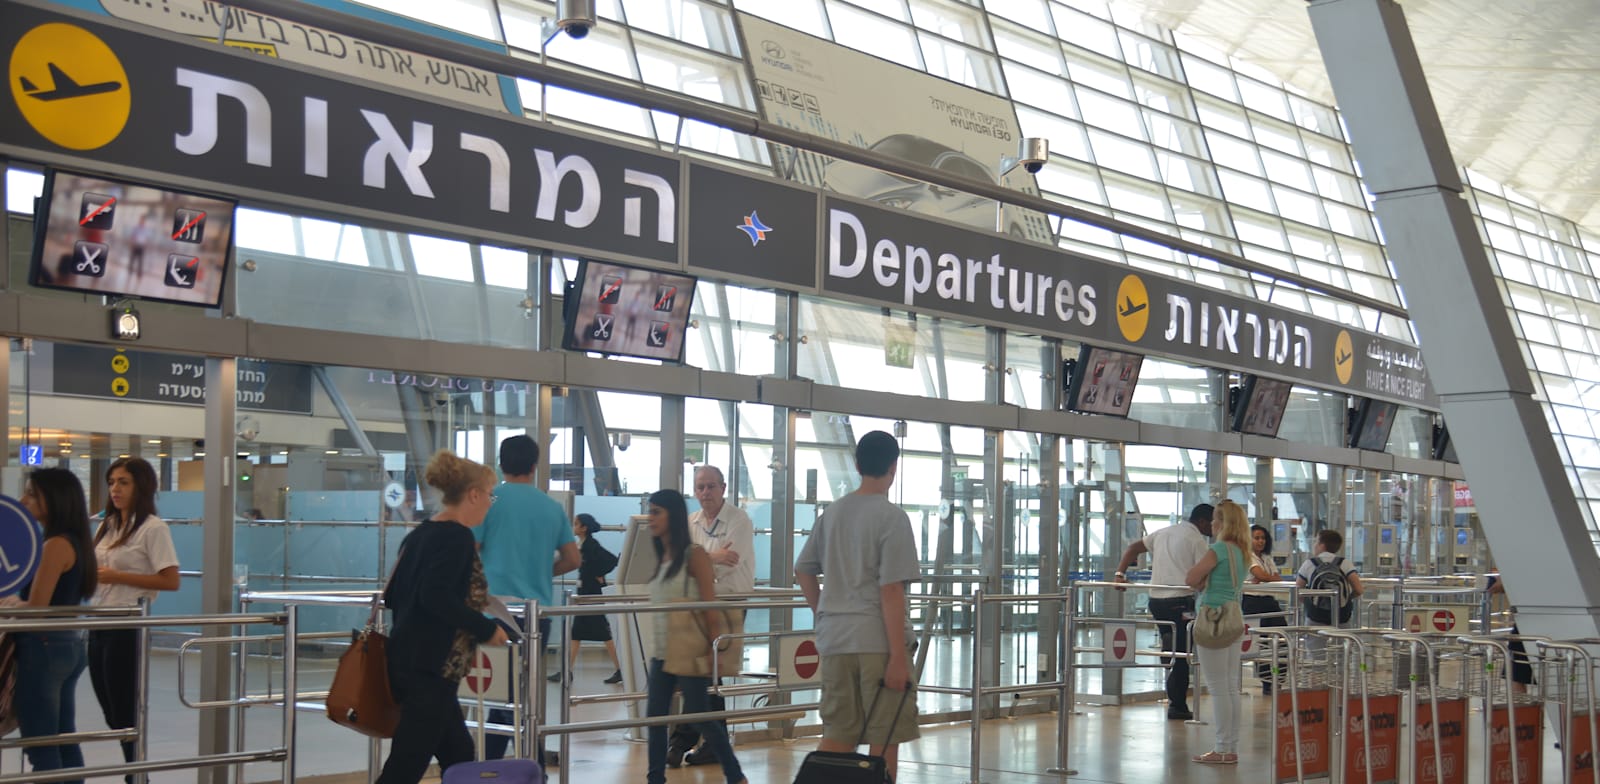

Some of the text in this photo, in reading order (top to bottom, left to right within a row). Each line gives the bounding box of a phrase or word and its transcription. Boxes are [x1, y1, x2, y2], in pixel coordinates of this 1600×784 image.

[292, 25, 347, 59] כבר
[354, 41, 417, 78] אתה
[425, 59, 492, 97] אבוש,
[949, 115, 992, 136] HYUNDAI
[174, 66, 675, 244] המראות
[828, 207, 1097, 327] Departures
[1164, 292, 1313, 370] המראות
[238, 369, 266, 384] החז
[1366, 369, 1426, 400] HAVE A NICE FLIGHT
